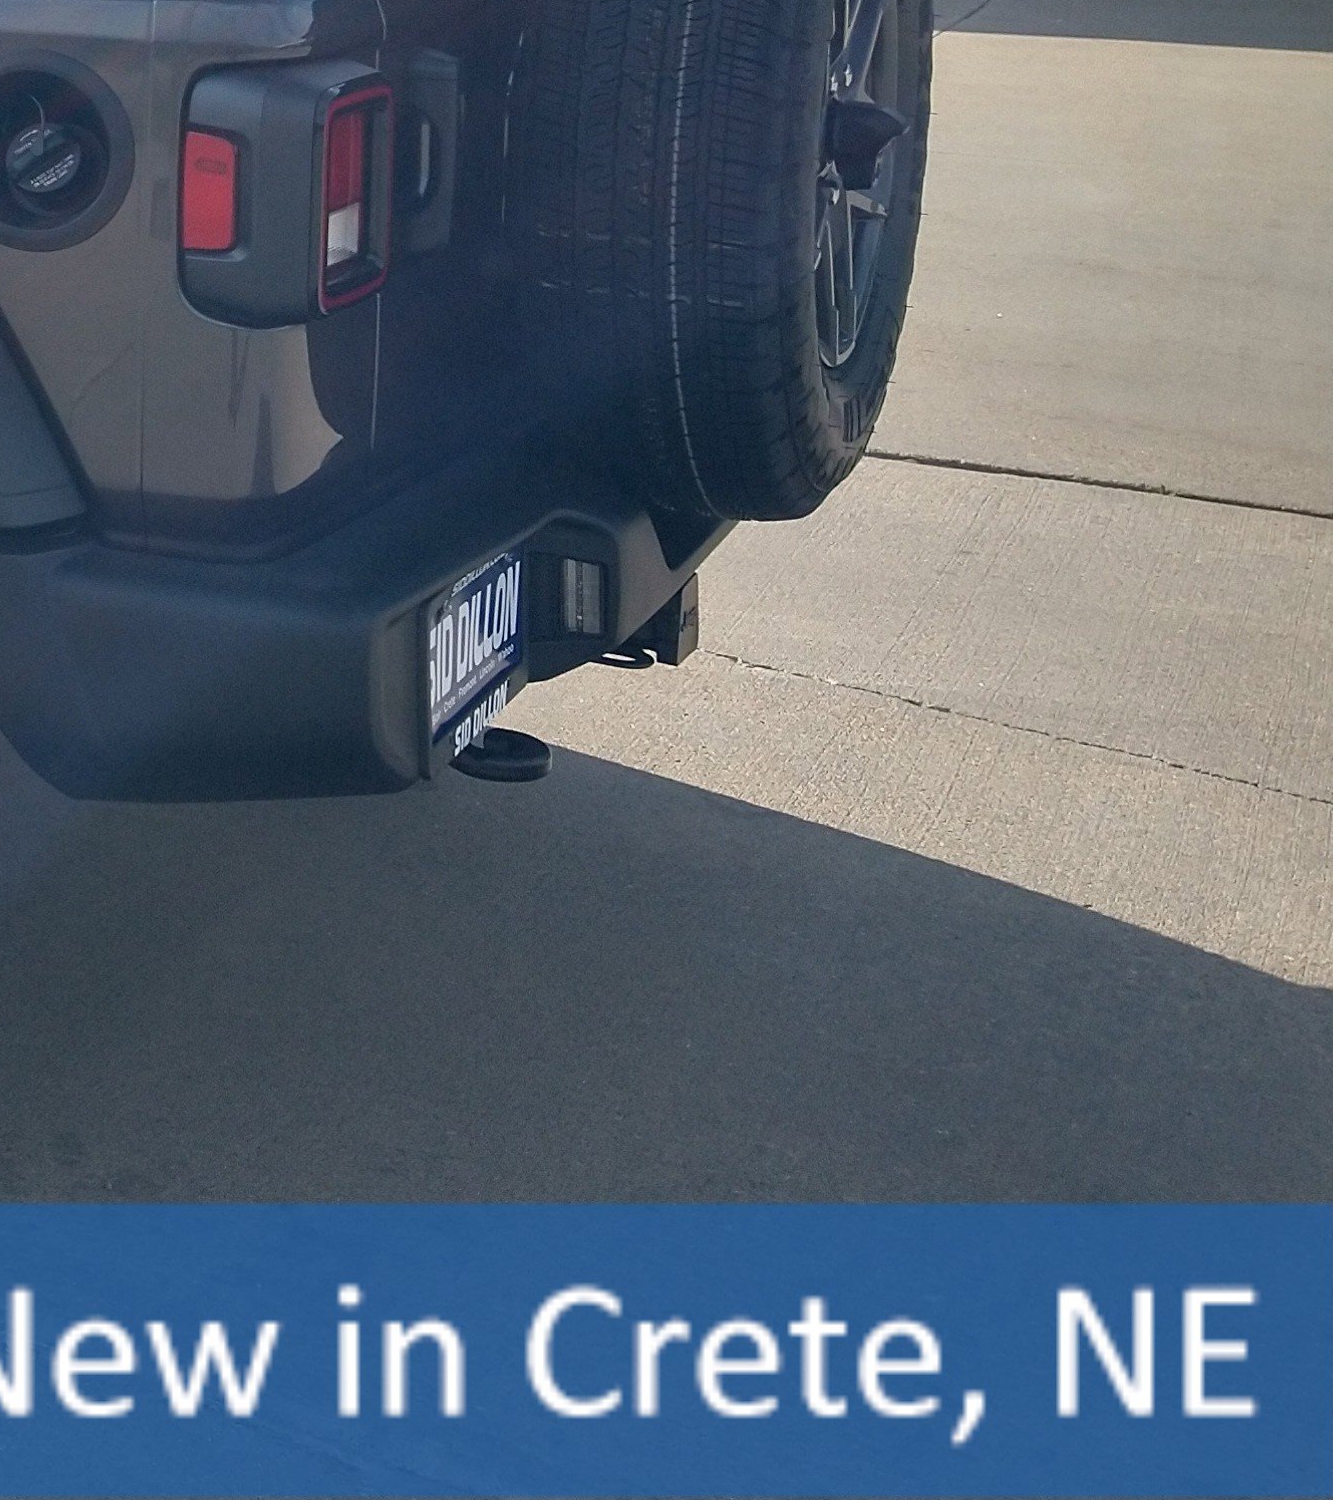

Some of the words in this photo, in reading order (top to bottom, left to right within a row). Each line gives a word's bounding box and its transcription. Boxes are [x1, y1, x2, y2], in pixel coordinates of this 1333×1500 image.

[457, 561, 521, 683] DILLON
[454, 716, 472, 758] SID
[472, 679, 508, 740] DILLON
